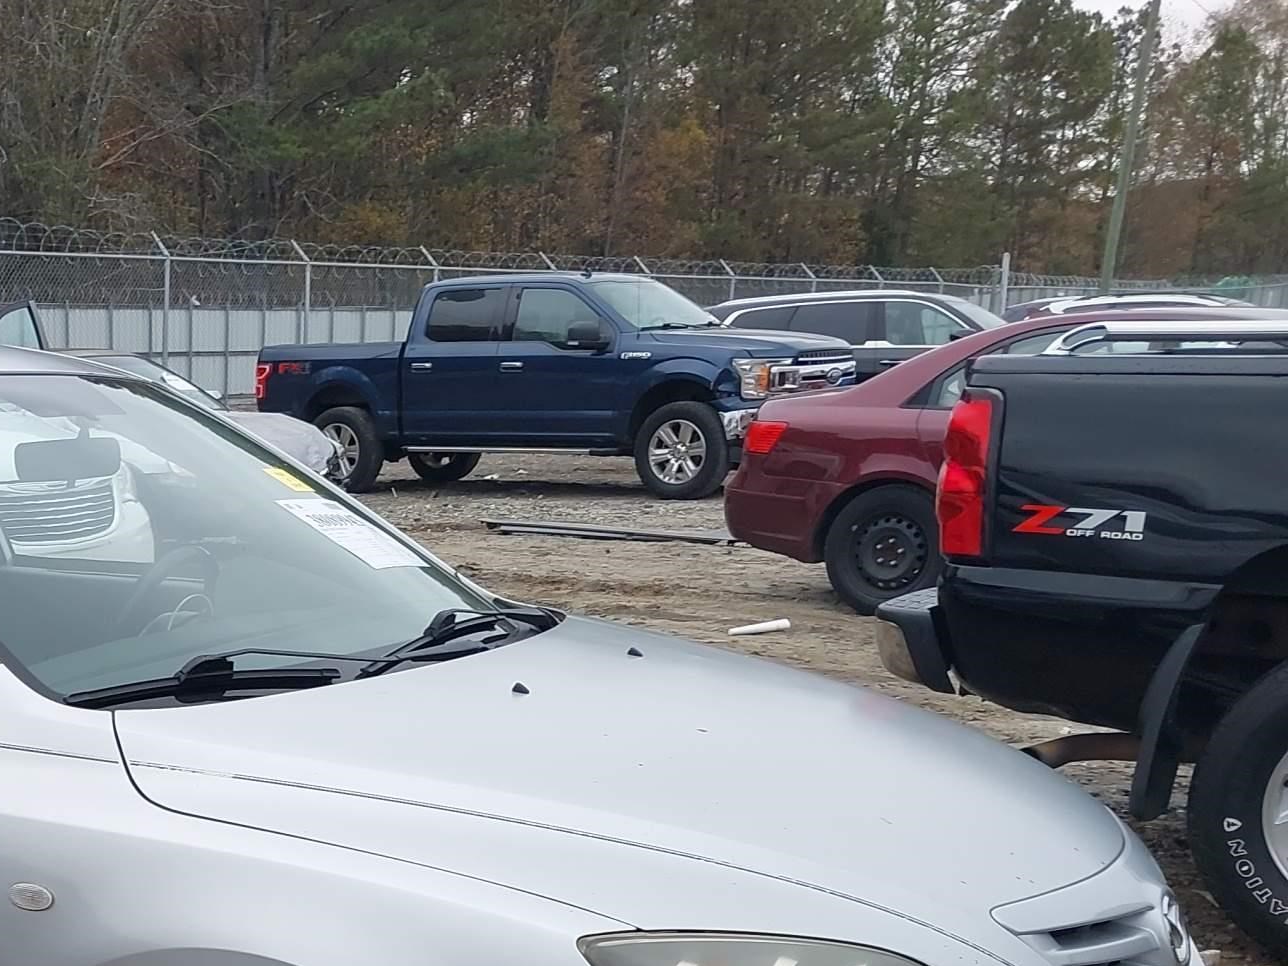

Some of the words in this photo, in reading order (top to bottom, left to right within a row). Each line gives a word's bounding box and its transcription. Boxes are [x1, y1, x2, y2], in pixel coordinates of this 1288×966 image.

[1012, 505, 1147, 534] Z71
[1065, 528, 1095, 538] OFF
[1100, 530, 1144, 541] ROAD
